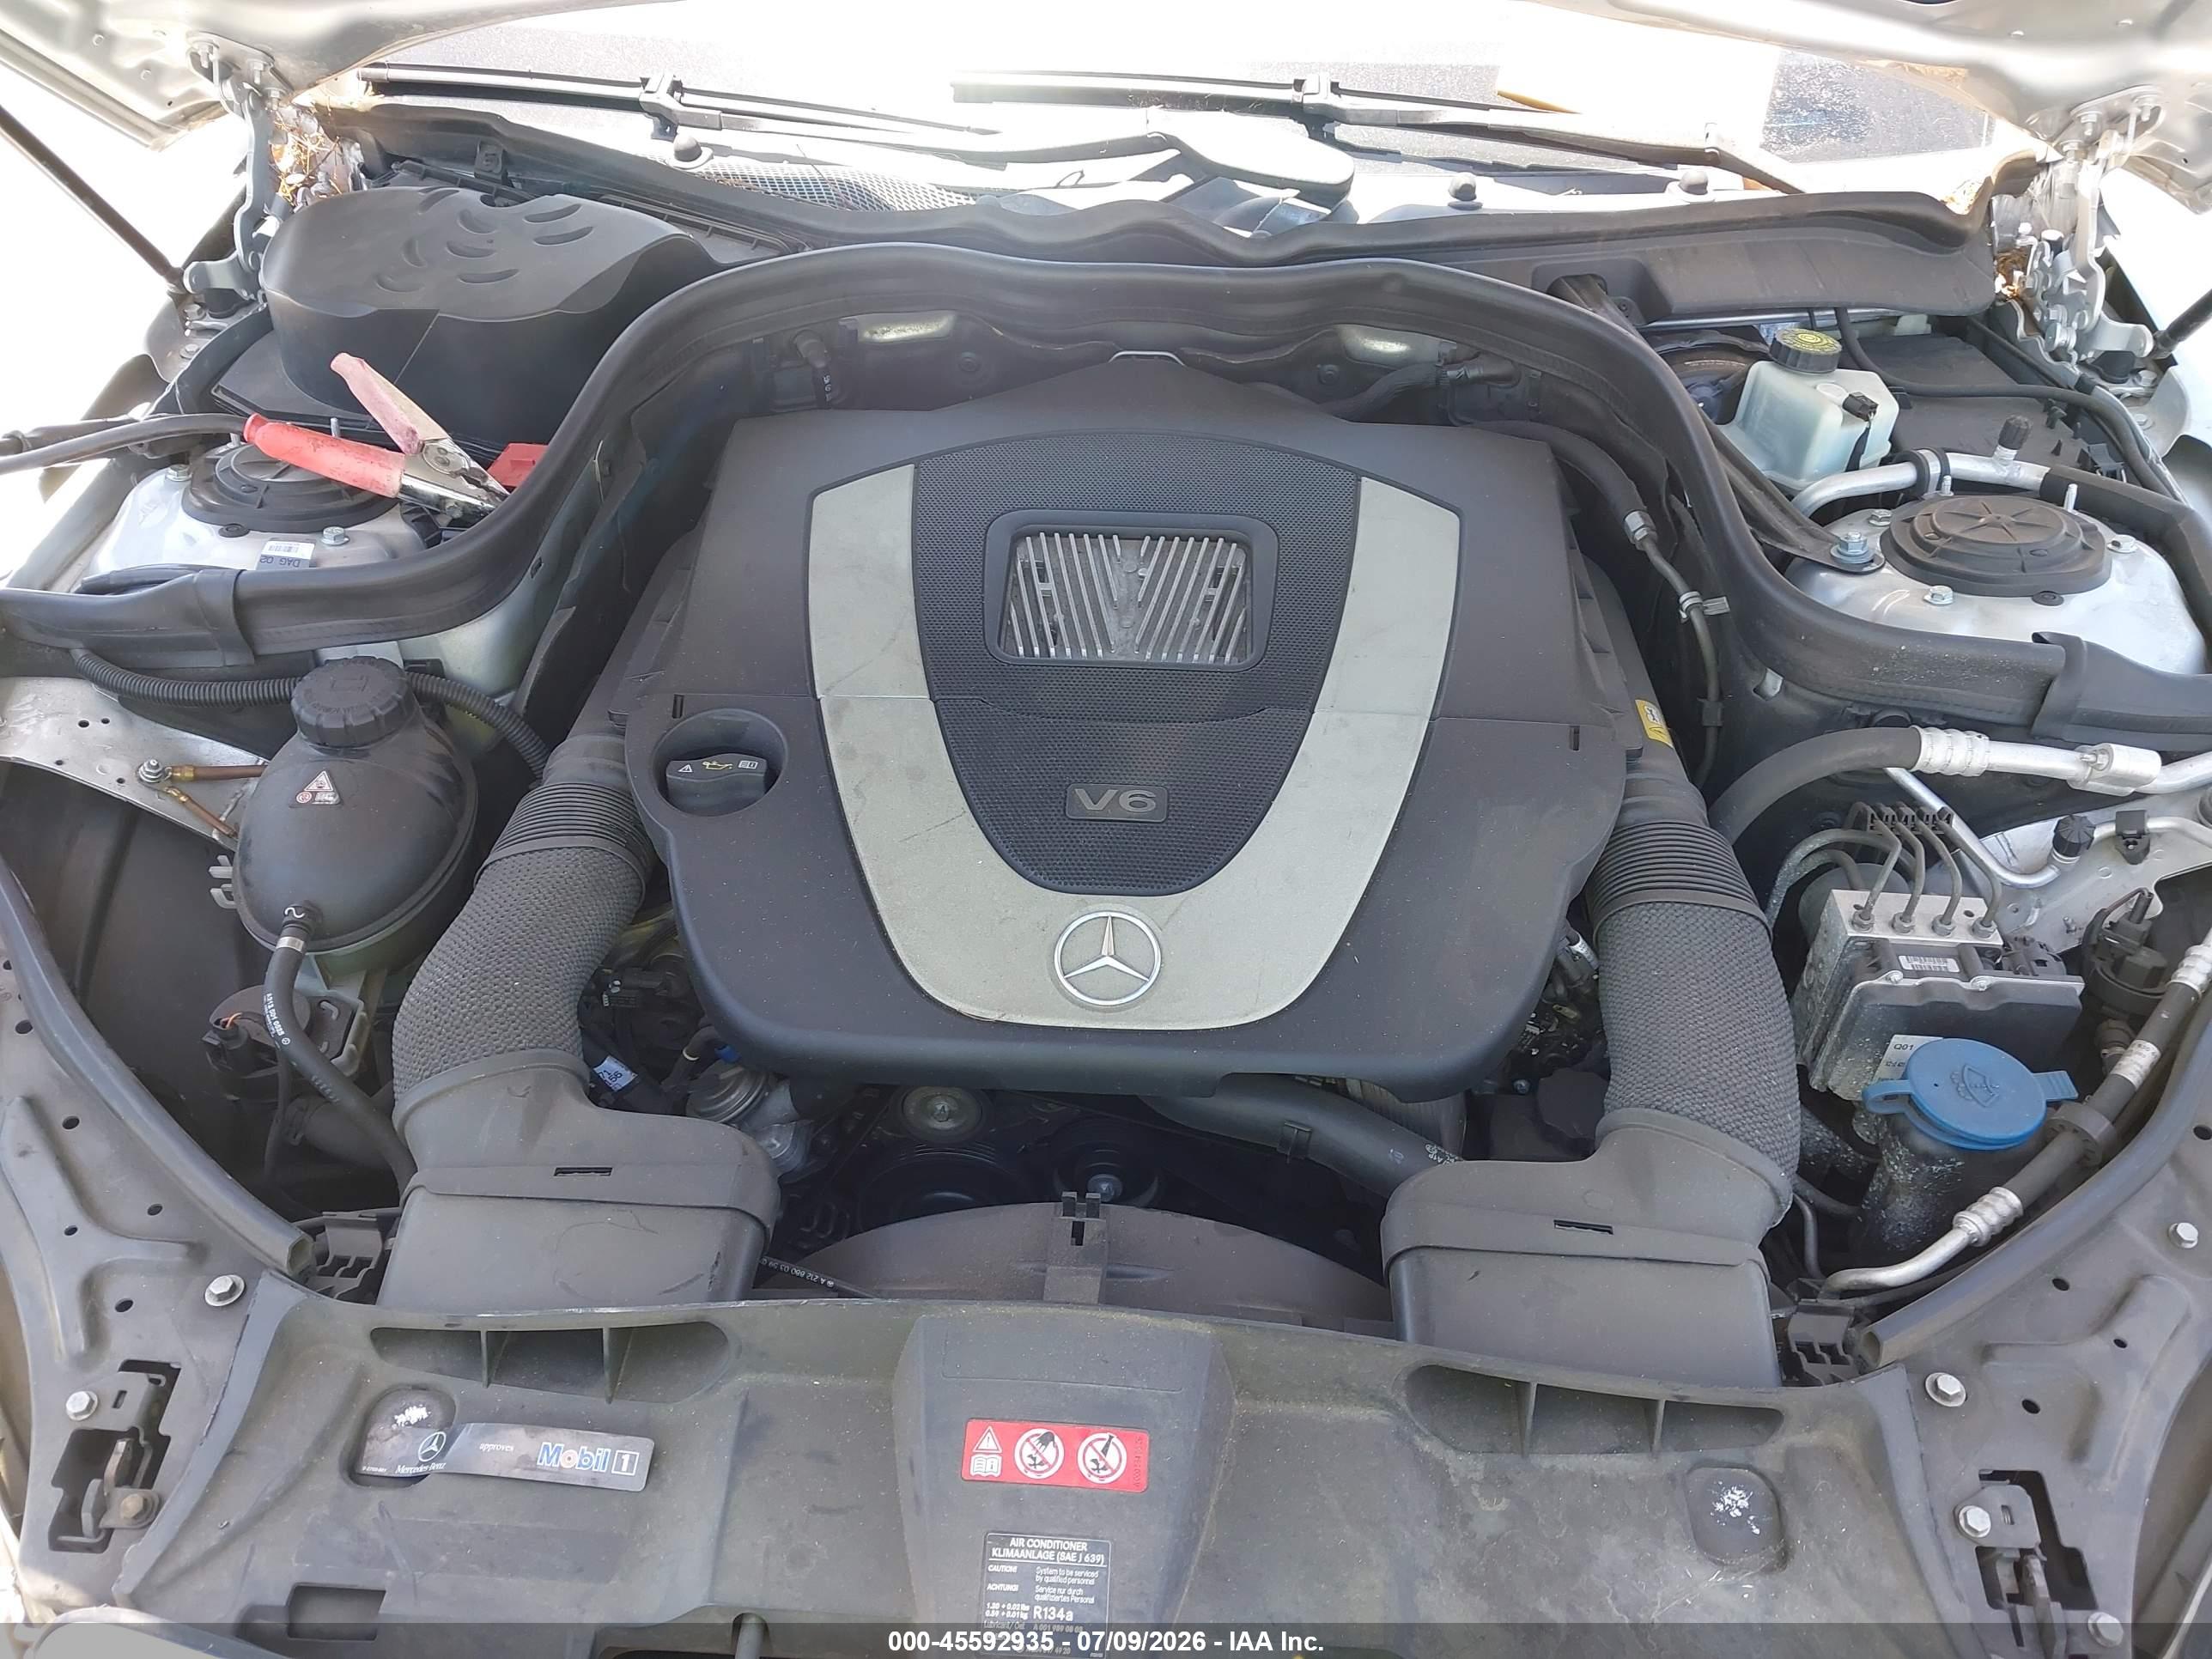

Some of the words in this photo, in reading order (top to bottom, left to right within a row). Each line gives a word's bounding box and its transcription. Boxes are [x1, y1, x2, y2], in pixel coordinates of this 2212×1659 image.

[259, 556, 274, 564] 02
[279, 557, 301, 568] DAG
[1075, 788, 1156, 812] V6
[479, 1442, 514, 1452] approves
[537, 1442, 611, 1473] Mobil
[395, 1462, 447, 1474] Mercedes-Benz
[1010, 1537, 1024, 1547] AIR
[1026, 1539, 1088, 1552] CONDITIONER
[992, 1547, 1055, 1560] KLIMAANLAGE
[1056, 1551, 1078, 1564] (SAE
[1084, 1553, 1105, 1565] 639)
[1033, 1605, 1074, 1622] R134a
